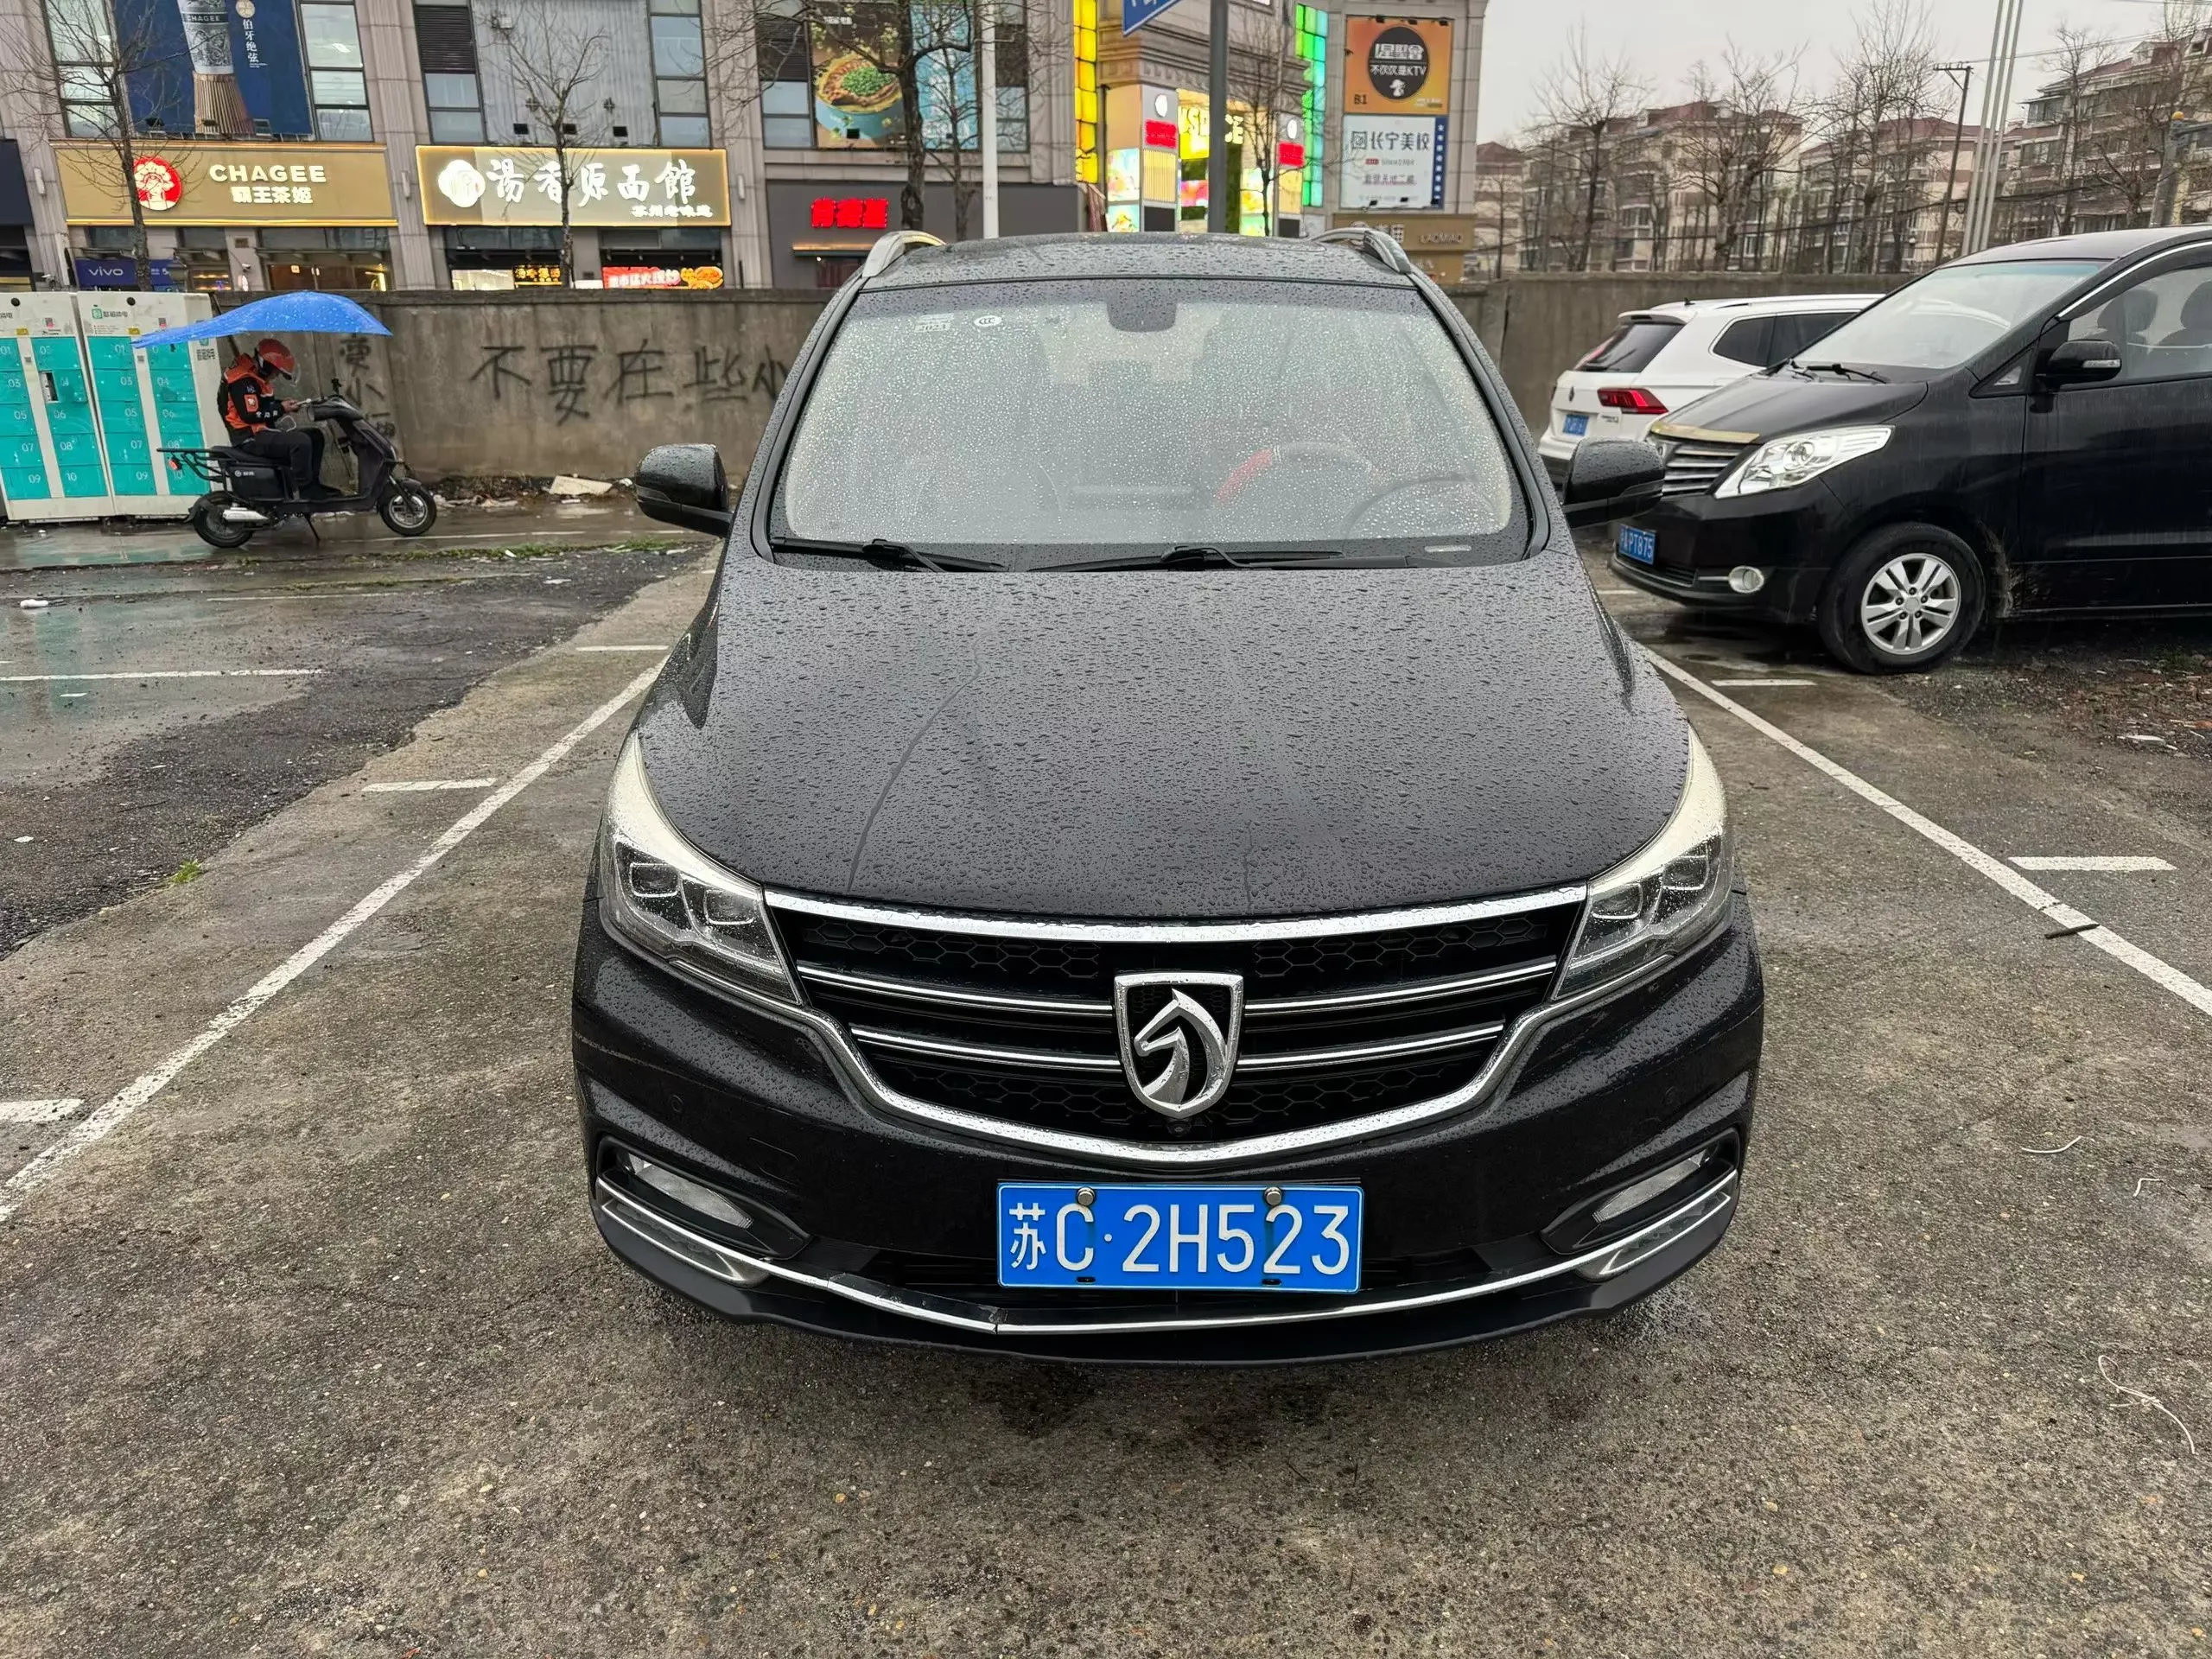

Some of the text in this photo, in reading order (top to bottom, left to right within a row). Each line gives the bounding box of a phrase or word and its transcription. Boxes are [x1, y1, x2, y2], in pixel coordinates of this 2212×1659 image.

[243, 19, 259, 63] 伯牙绝弦
[1354, 93, 1368, 105] B1
[209, 164, 327, 183] CHAGEE
[231, 186, 313, 204] 霸王茶姬
[88, 266, 124, 276] vivo
[8, 378, 21, 388] 03
[120, 377, 133, 386] 03
[157, 377, 169, 386] 04
[14, 410, 28, 420] 05
[54, 410, 67, 419] 06
[124, 408, 138, 417] 05
[162, 409, 175, 418] 06
[22, 442, 35, 452] 07
[60, 442, 73, 451] 08
[130, 439, 143, 449] 07
[28, 474, 41, 484] 09
[66, 472, 78, 482] 10
[136, 471, 149, 480] 09
[1008, 1201, 1351, 1275] 苏C·2H523
